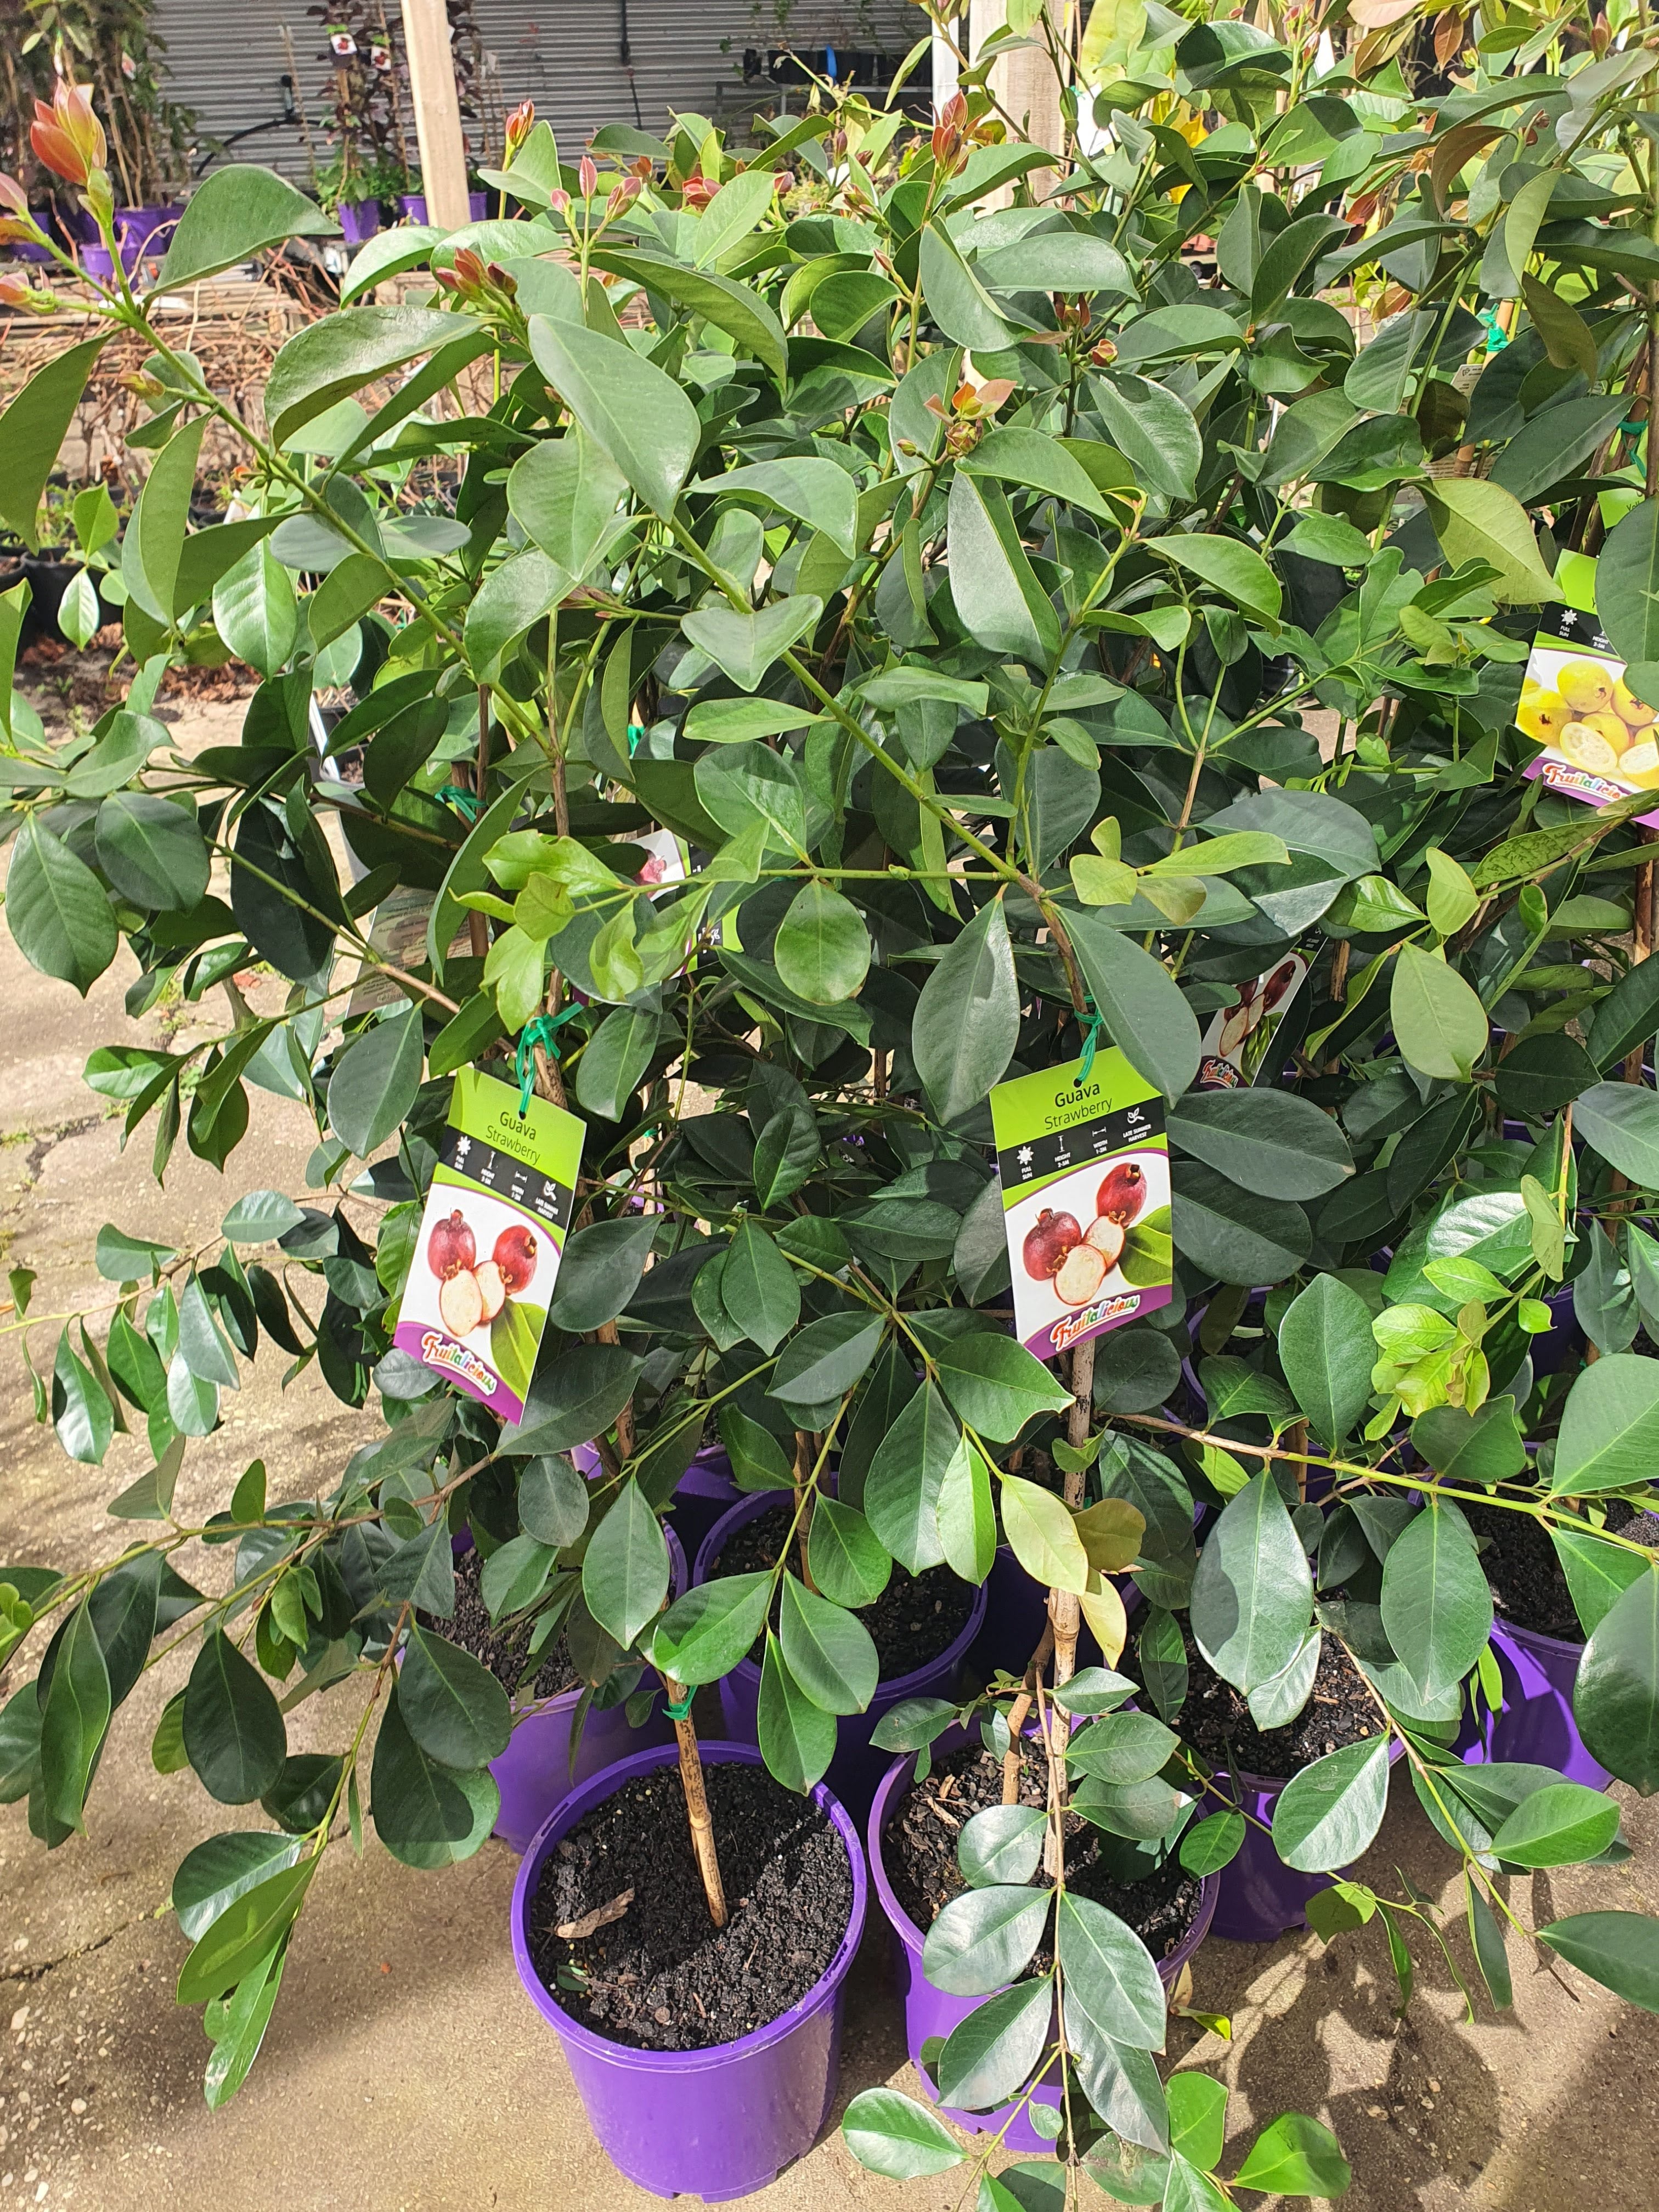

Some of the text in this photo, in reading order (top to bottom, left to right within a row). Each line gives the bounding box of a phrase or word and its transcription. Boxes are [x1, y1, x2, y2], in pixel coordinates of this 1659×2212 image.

[1592, 635, 1609, 645] HEIGHT
[1543, 763, 1624, 800] Fruitalicio
[1054, 1082, 1101, 1108] Guava
[1044, 1097, 1113, 1130] Strawberry
[500, 1111, 537, 1141] Guava
[1122, 1124, 1152, 1138] LATE SUMMER
[1093, 1139, 1108, 1149] WIDTH
[1128, 1131, 1148, 1143] HARVEST
[486, 1125, 541, 1166] Strawberry
[1054, 1152, 1071, 1163] HEIGHT
[1057, 1160, 1070, 1168] 2-5M
[1022, 1165, 1032, 1174] FULL
[1022, 1172, 1032, 1180] SUN
[1051, 1296, 1139, 1350] Fruitalicious
[422, 1332, 496, 1393] Fruitalicious
